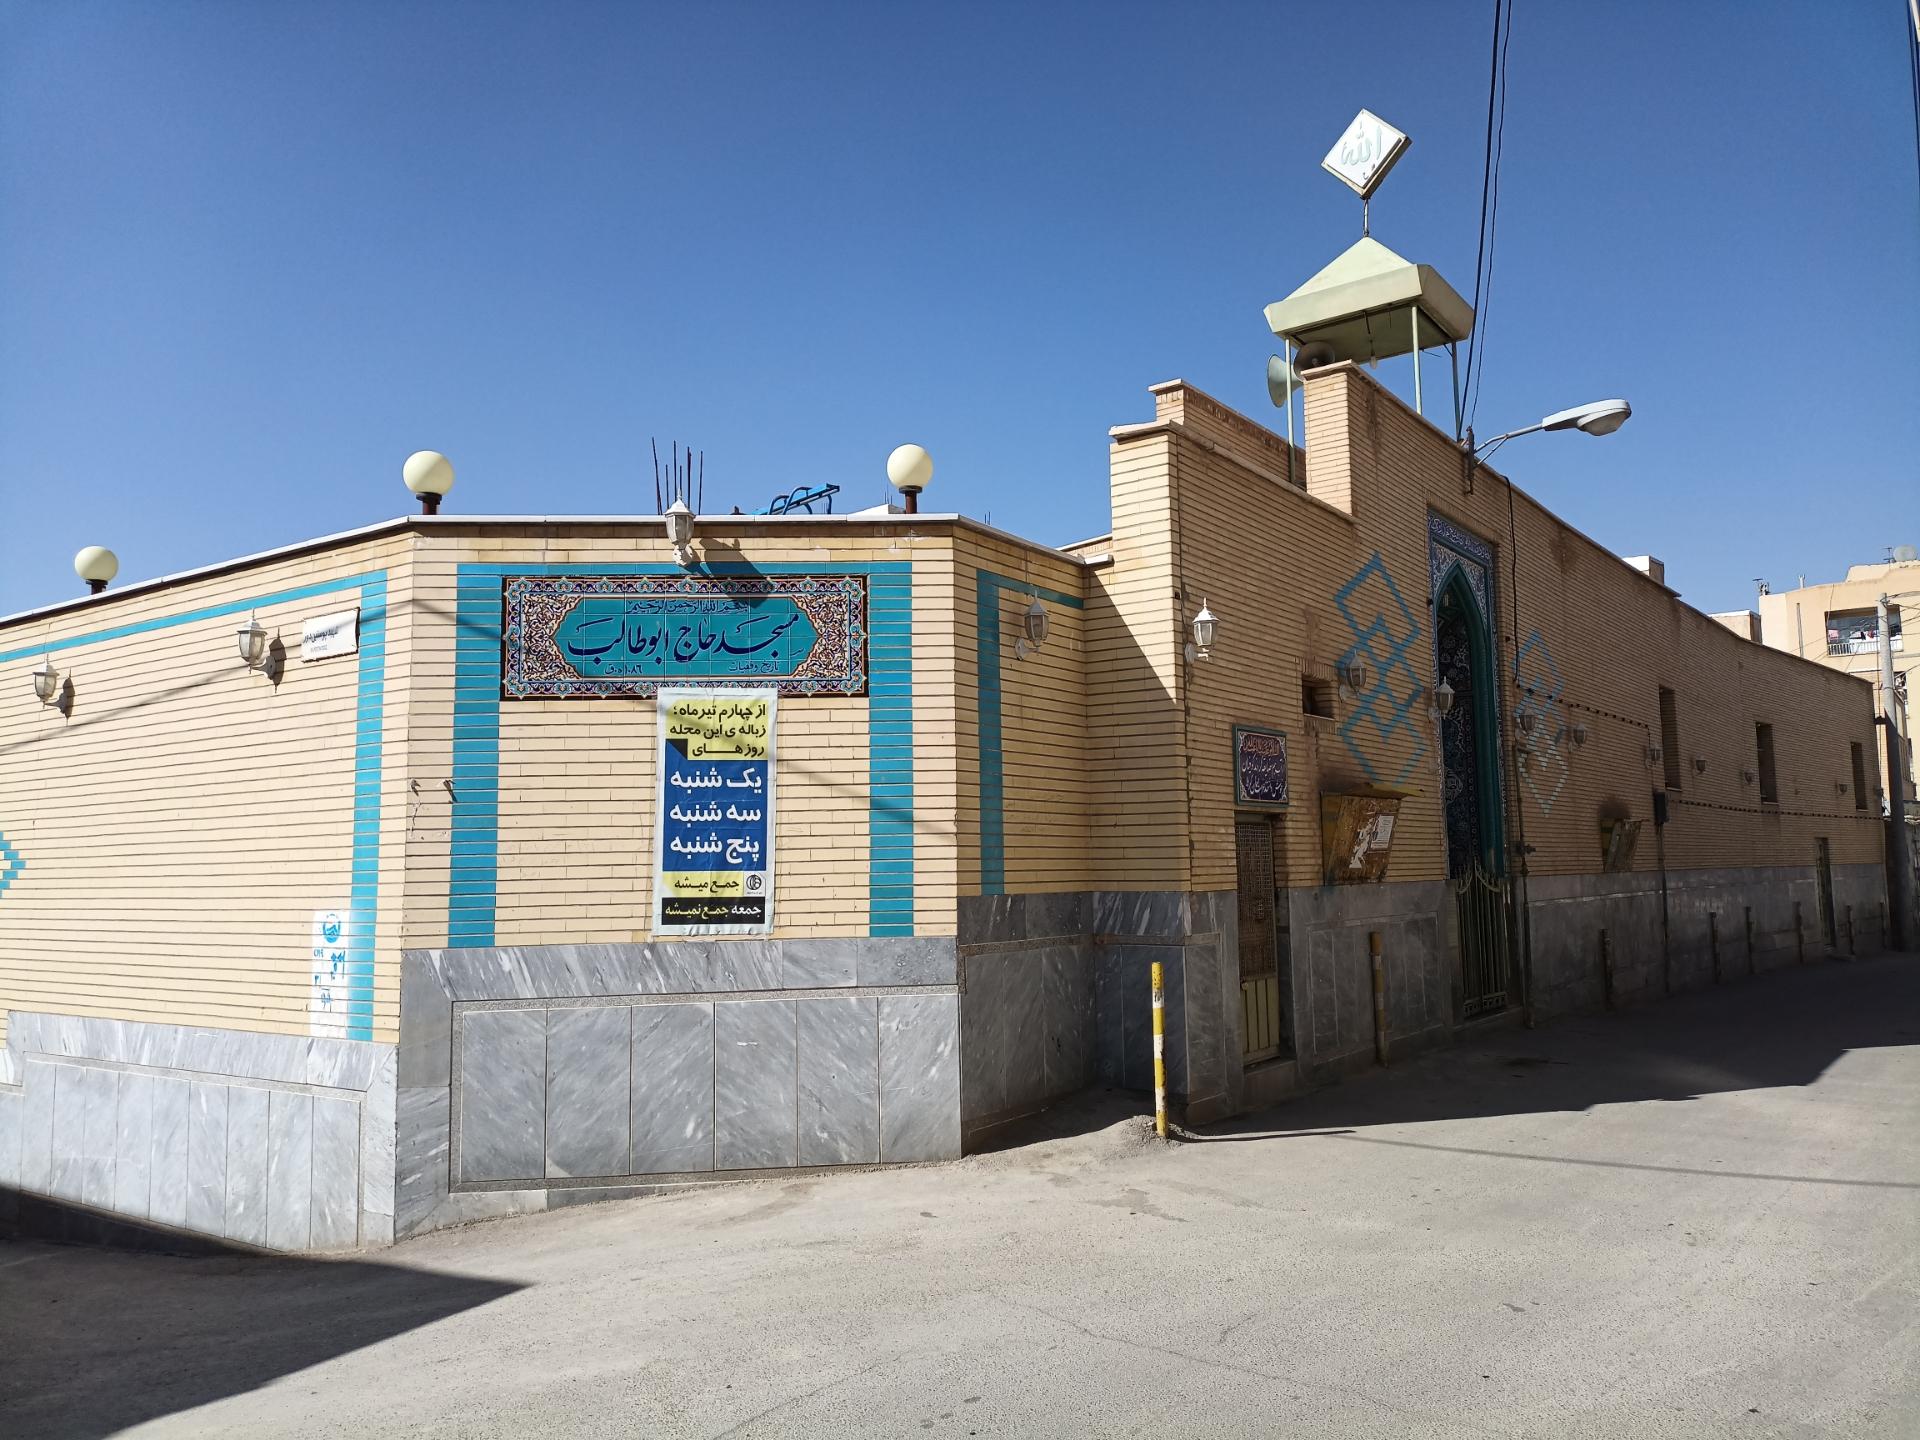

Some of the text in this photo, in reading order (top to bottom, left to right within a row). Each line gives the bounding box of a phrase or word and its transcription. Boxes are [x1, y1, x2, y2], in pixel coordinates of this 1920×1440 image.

[1339, 120, 1383, 166] الله
[673, 618, 717, 663] حاج
[712, 613, 800, 659] مسجد
[760, 659, 779, 674] تاریخ
[718, 703, 753, 723] چهارم
[755, 703, 766, 719] از
[669, 723, 701, 735] محله
[703, 724, 723, 740] این
[738, 724, 767, 738] زباله
[670, 767, 762, 794] یک شنبه
[669, 800, 762, 828] سه شنبه
[670, 832, 760, 864] پنج شنبه
[674, 876, 740, 893] جمع میشه
[665, 902, 762, 920] جمعه جمع نمیشه
